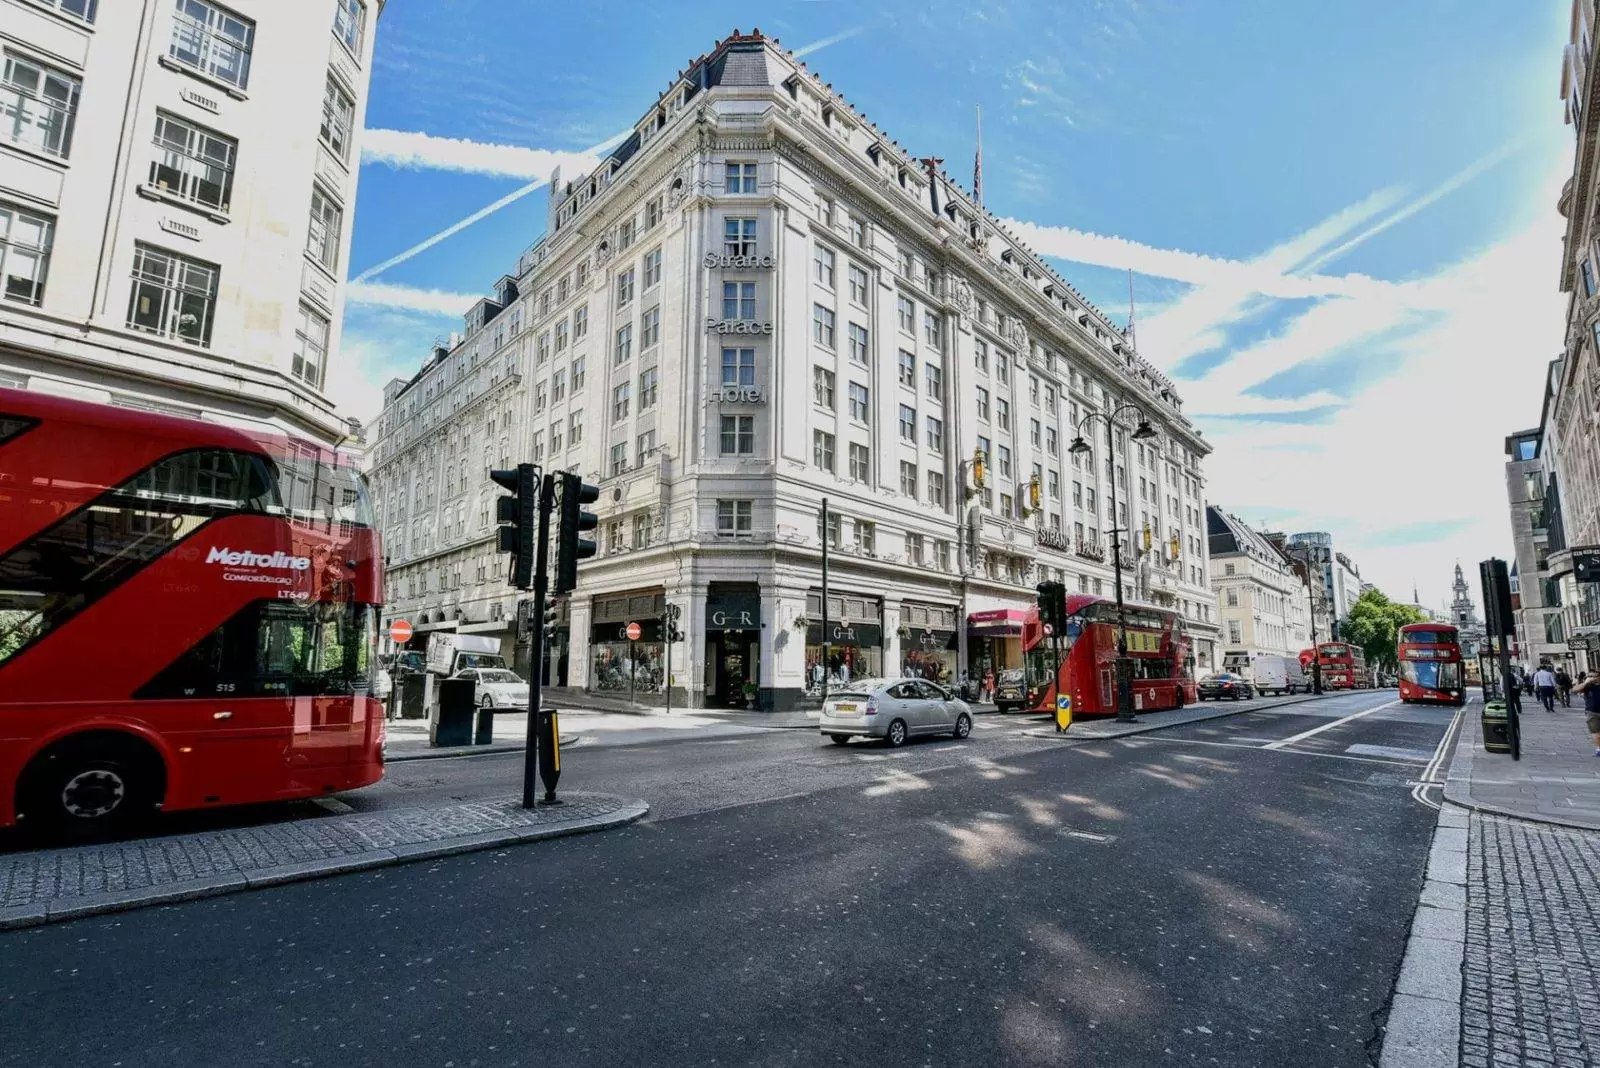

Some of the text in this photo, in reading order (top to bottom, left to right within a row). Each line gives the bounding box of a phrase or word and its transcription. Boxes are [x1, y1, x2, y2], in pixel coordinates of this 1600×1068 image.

[703, 251, 776, 269] Strand
[704, 317, 774, 335] Palace
[709, 384, 768, 403] Hotel
[205, 546, 311, 570] Metroline
[1083, 540, 1106, 558] PALAC
[278, 590, 309, 600] LT649
[216, 683, 236, 692] 515
